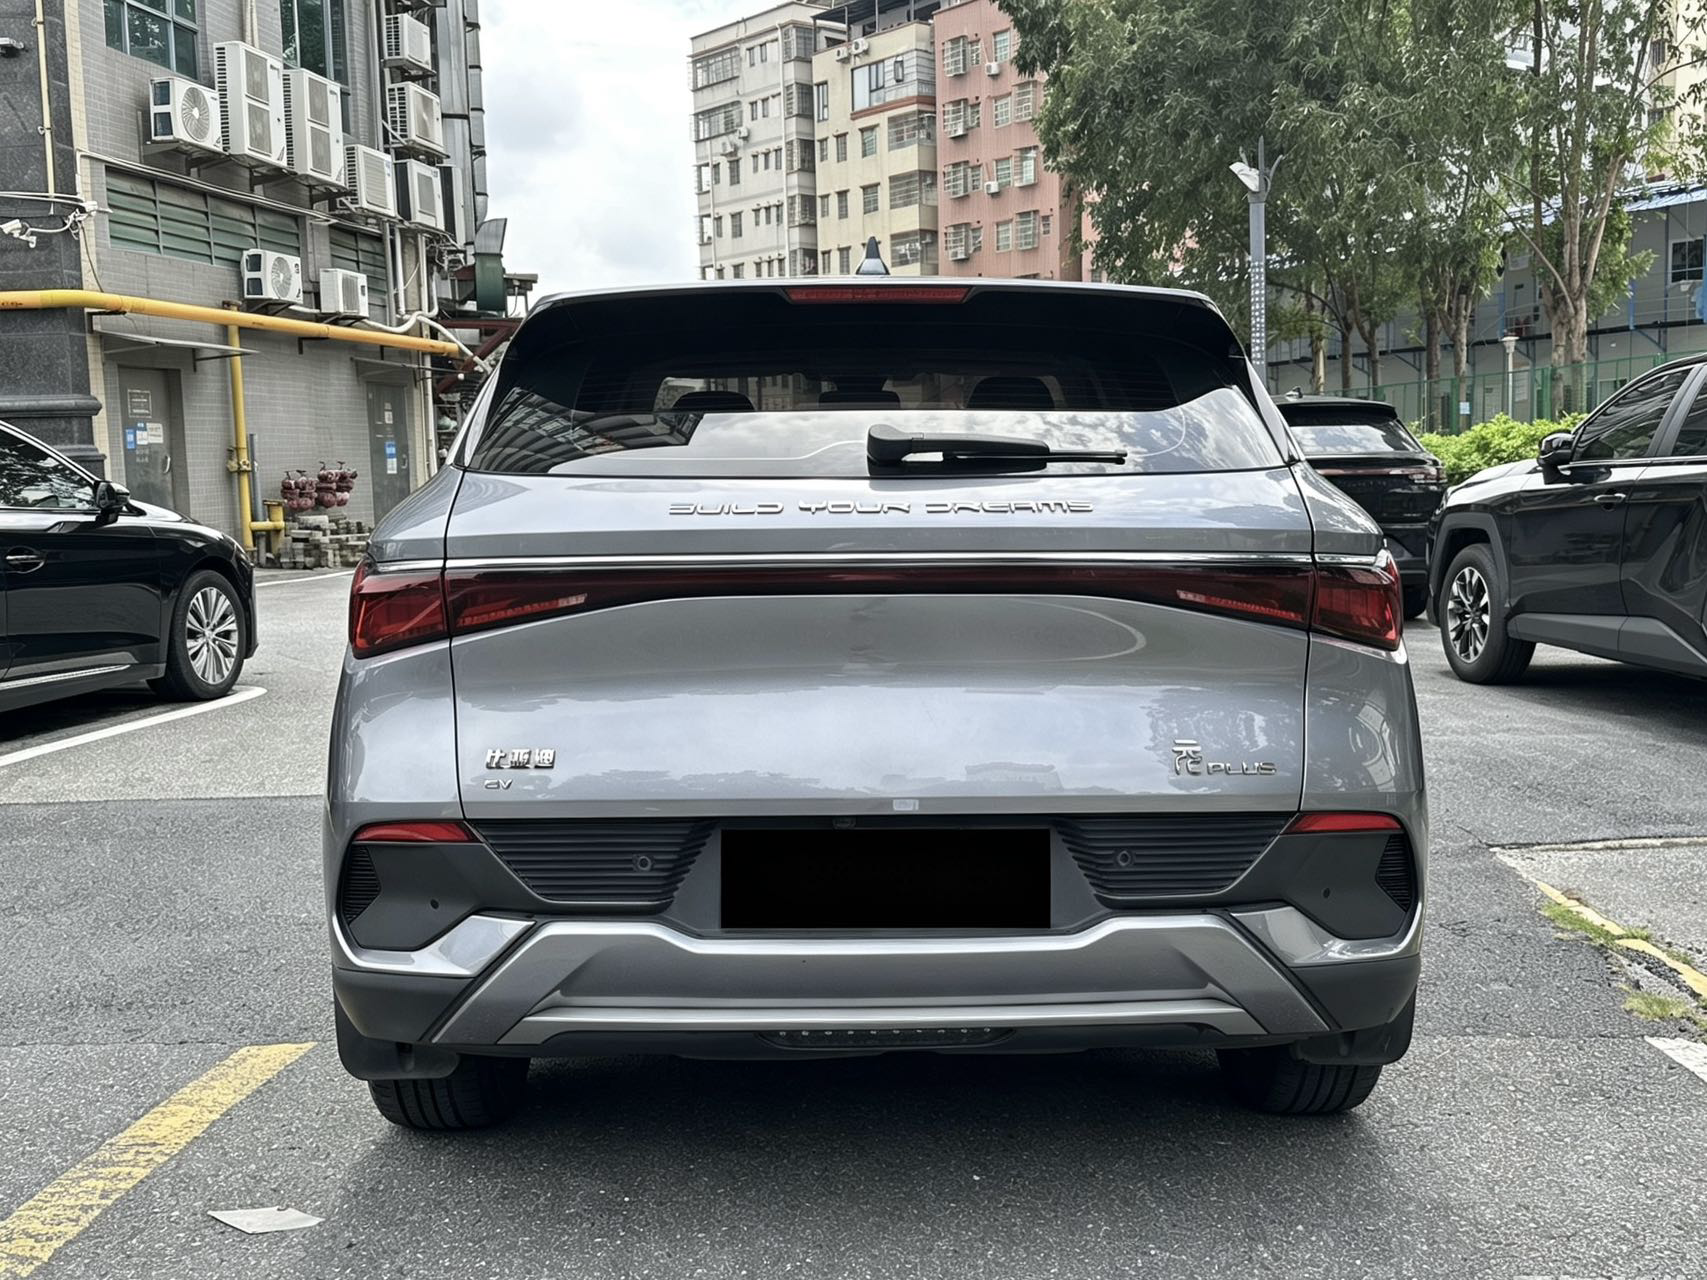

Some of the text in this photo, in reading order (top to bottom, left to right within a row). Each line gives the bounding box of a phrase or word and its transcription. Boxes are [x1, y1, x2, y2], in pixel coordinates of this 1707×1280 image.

[668, 500, 1094, 516] BUILD YOUR DREAMS
[485, 748, 556, 770] 比亚迪
[1172, 739, 1277, 776] 元 PLUS
